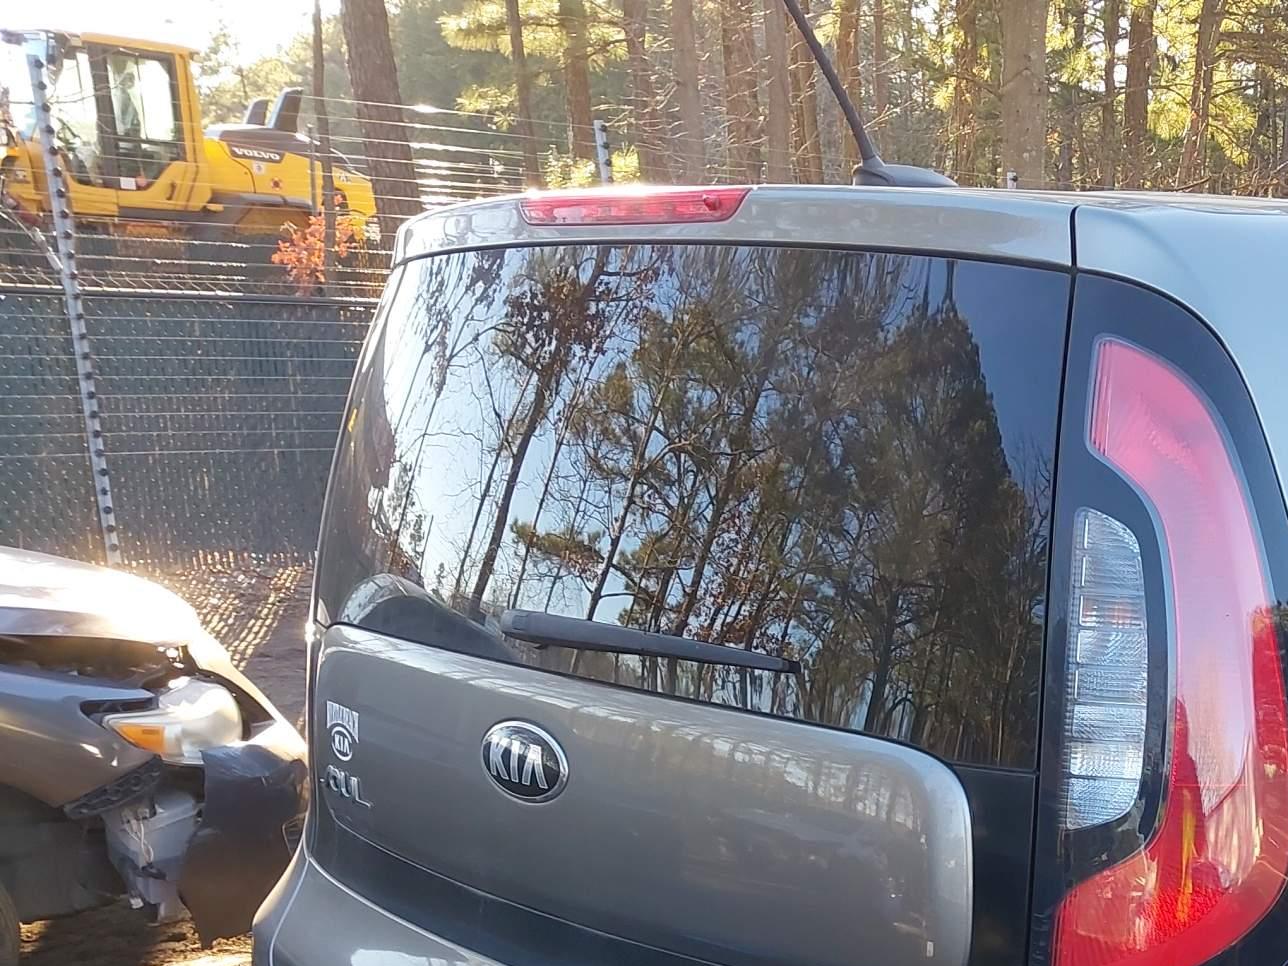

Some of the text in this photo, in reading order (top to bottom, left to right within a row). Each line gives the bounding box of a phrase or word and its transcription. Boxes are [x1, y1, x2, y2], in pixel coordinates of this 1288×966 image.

[231, 147, 281, 161] VOLVO
[334, 733, 351, 755] KIA
[489, 735, 549, 789] KIA
